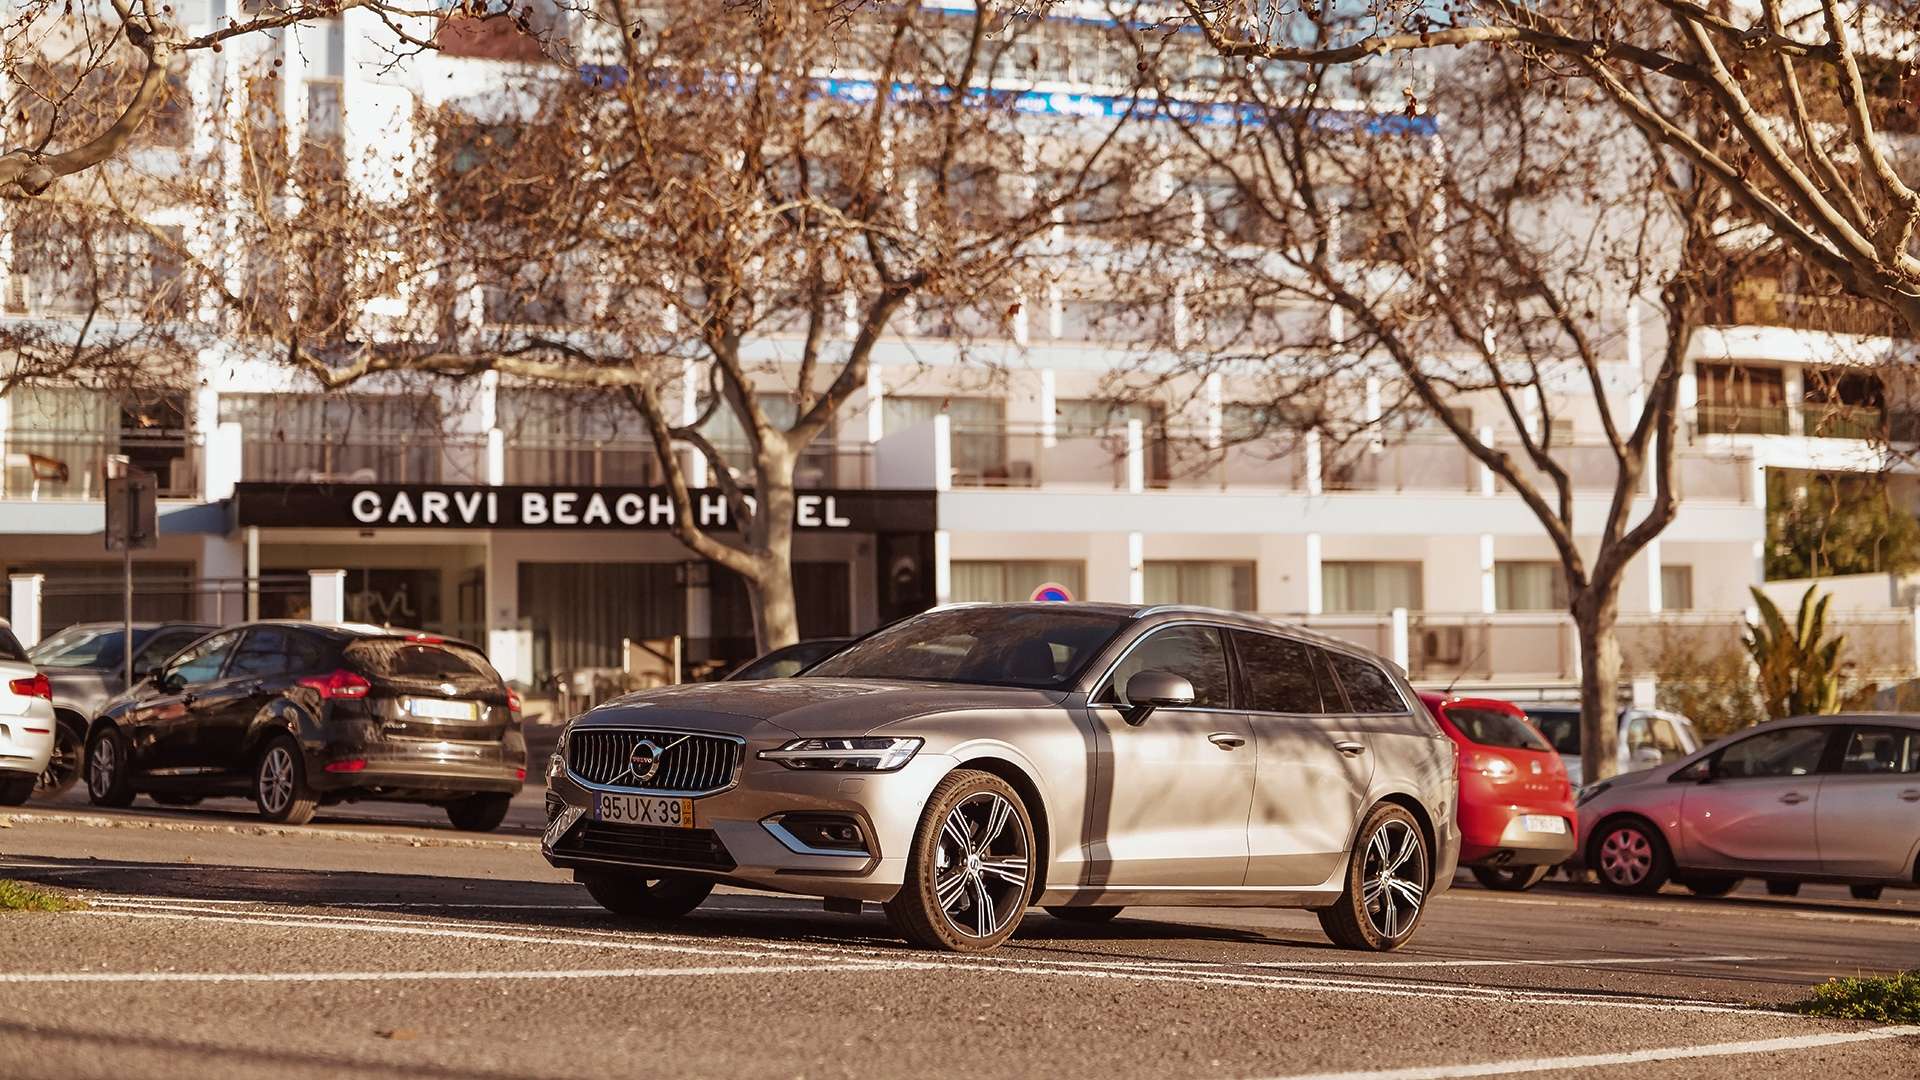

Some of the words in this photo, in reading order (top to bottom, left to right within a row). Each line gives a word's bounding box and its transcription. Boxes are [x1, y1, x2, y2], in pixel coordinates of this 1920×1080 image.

[351, 490, 498, 524] CARVI
[521, 492, 676, 525] BEACH
[700, 494, 851, 527] HEL
